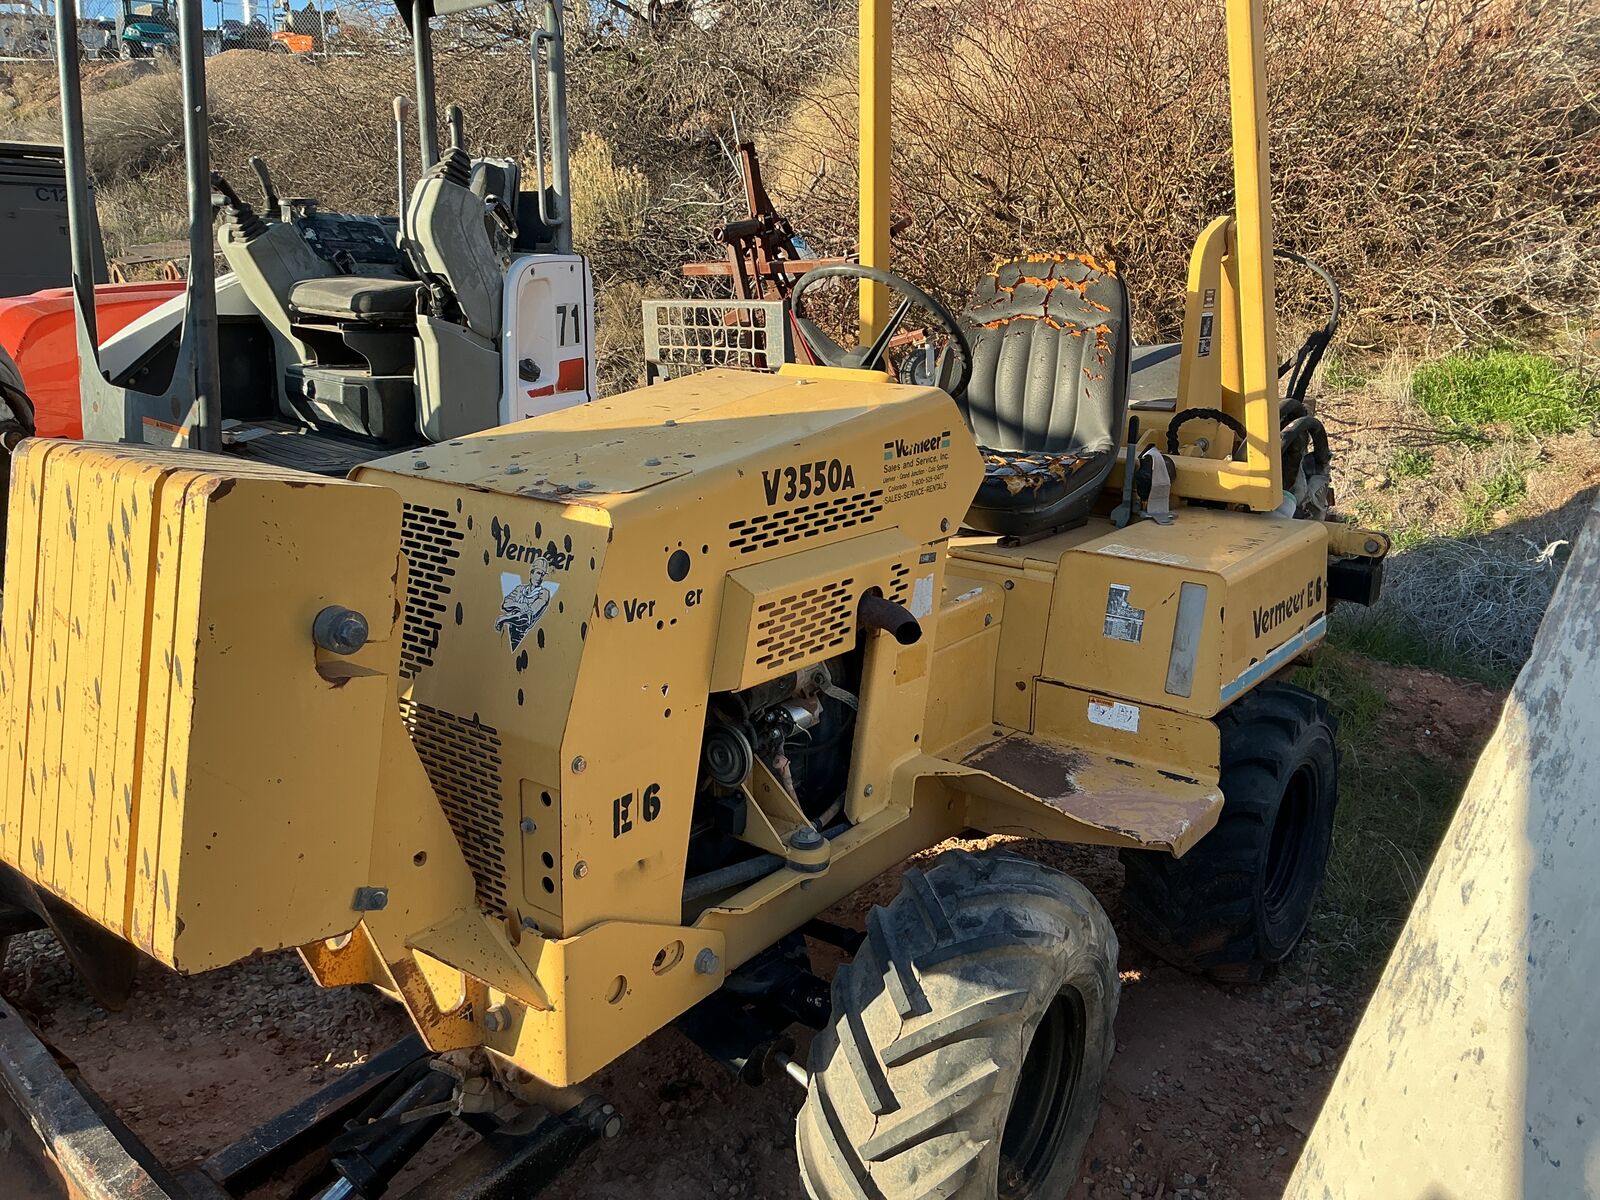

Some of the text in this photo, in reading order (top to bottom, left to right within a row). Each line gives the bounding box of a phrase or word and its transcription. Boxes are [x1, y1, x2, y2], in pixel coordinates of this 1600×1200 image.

[557, 304, 580, 346] 71
[883, 463, 901, 473] Sales
[902, 460, 914, 469] and
[888, 483, 907, 492] Colorado
[493, 523, 574, 571] Vermeer
[1253, 588, 1305, 639] Vermeer
